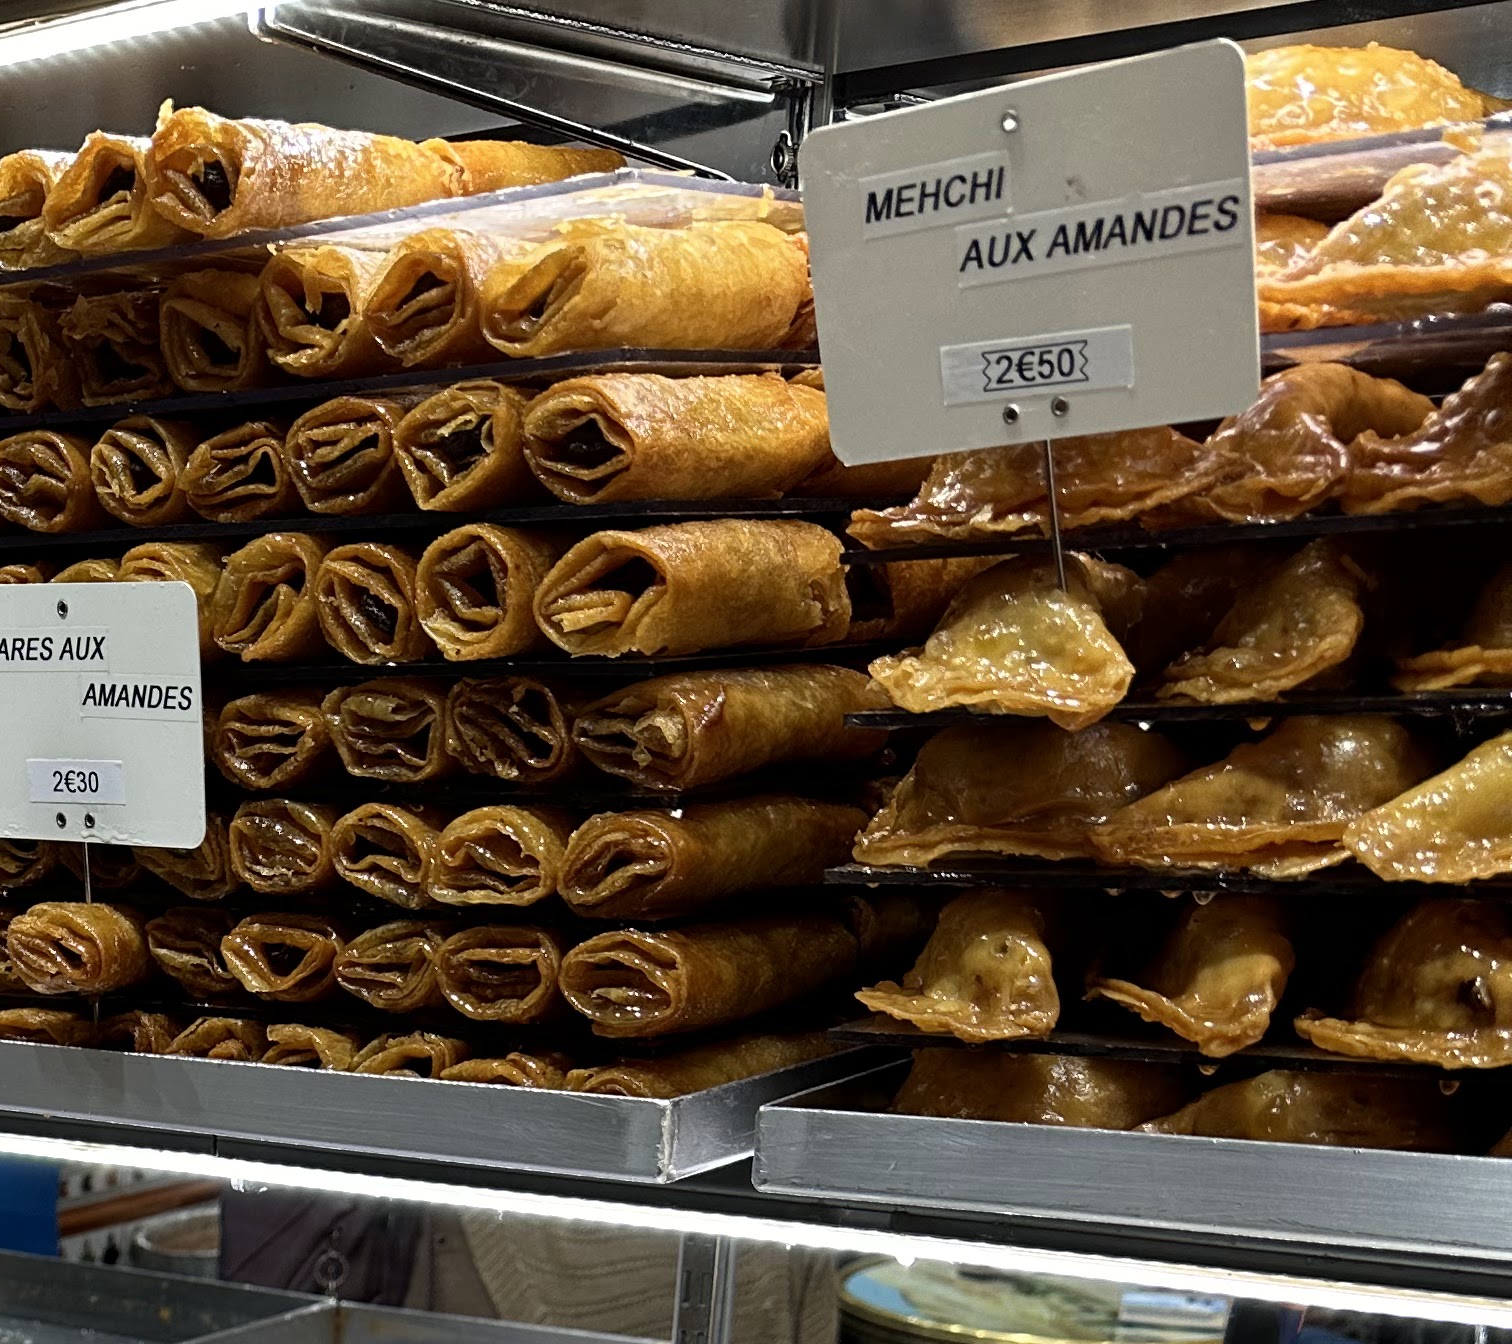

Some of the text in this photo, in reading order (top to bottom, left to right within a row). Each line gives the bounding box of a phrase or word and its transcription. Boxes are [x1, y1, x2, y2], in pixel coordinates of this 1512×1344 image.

[864, 166, 1006, 224] MEHCHI
[959, 195, 1241, 273] AUX AMANDES
[995, 347, 1076, 386] 2€50
[59, 636, 106, 661] AUX
[82, 683, 193, 711] AMANDES
[52, 770, 100, 793] 2€30
